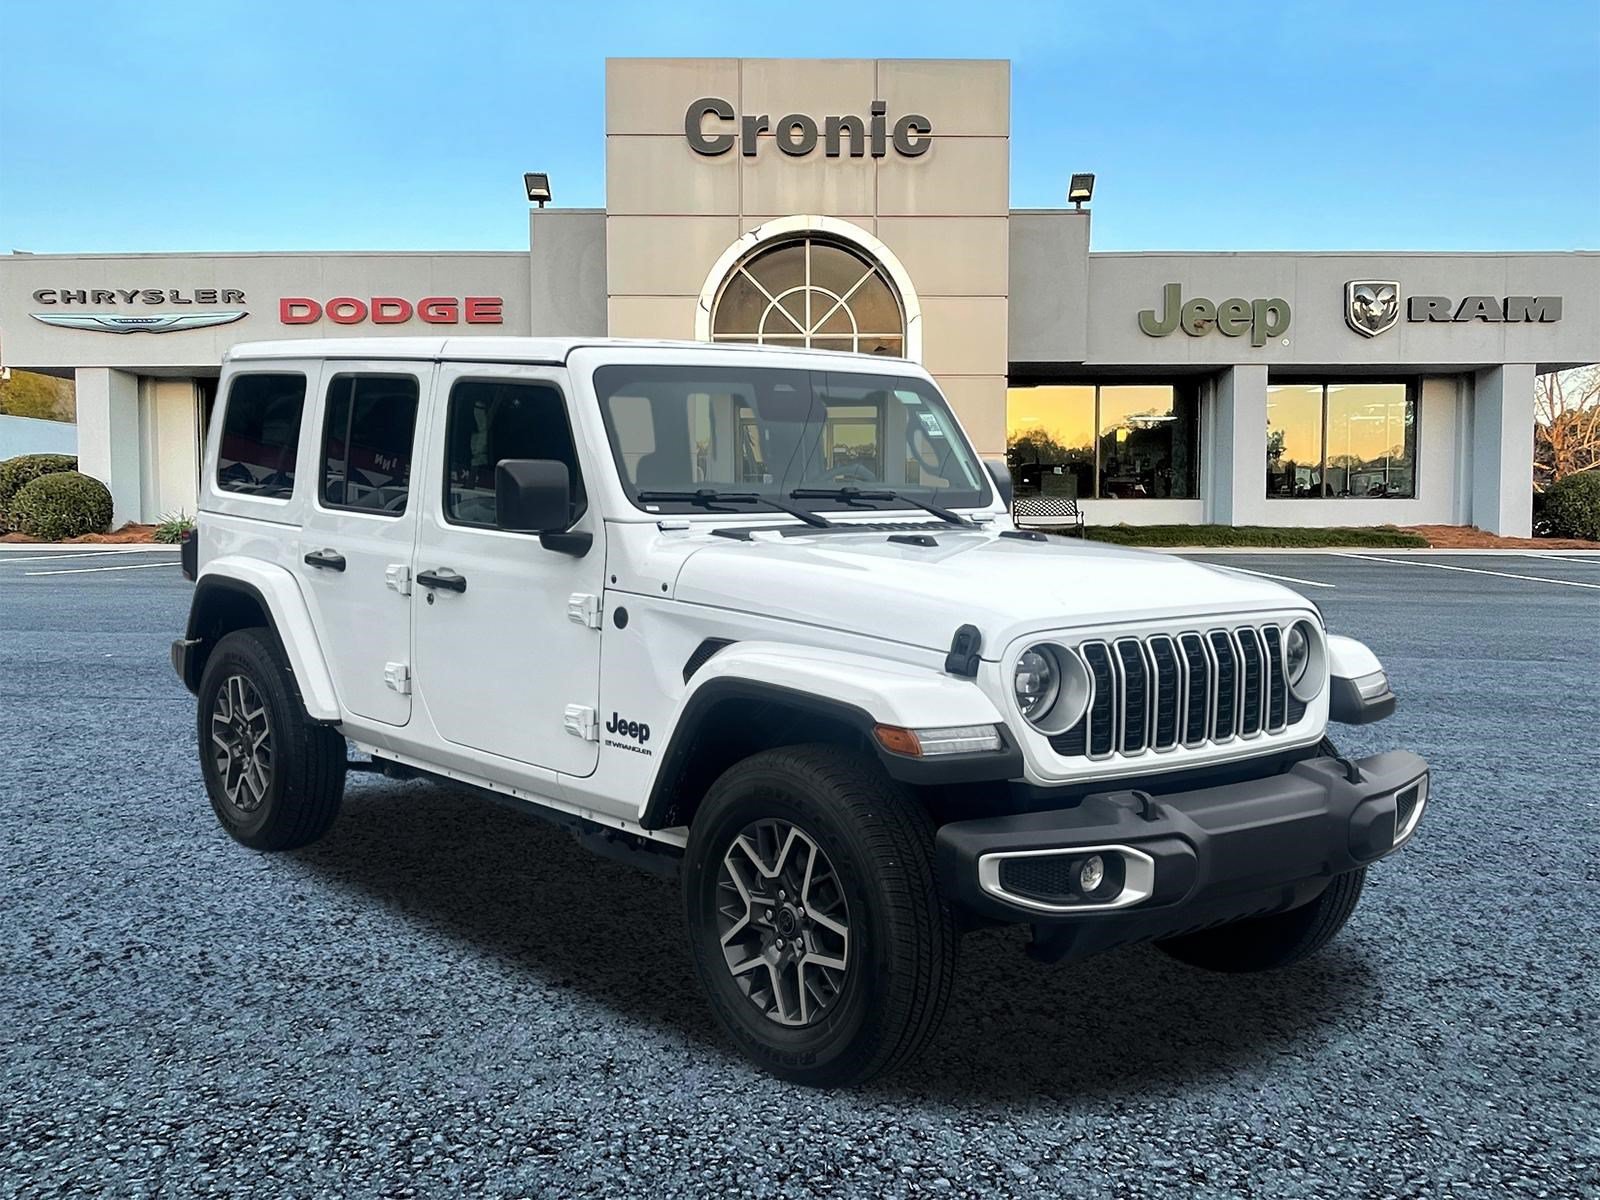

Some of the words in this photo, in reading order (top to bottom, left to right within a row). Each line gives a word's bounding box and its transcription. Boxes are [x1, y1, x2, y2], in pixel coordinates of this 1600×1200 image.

[685, 97, 932, 157] Cronic
[33, 289, 246, 304] CHRYSLER
[280, 298, 503, 324] DODGE
[1407, 296, 1563, 322] RAM
[1138, 283, 1291, 347] Jeep
[606, 712, 650, 744] Jeep
